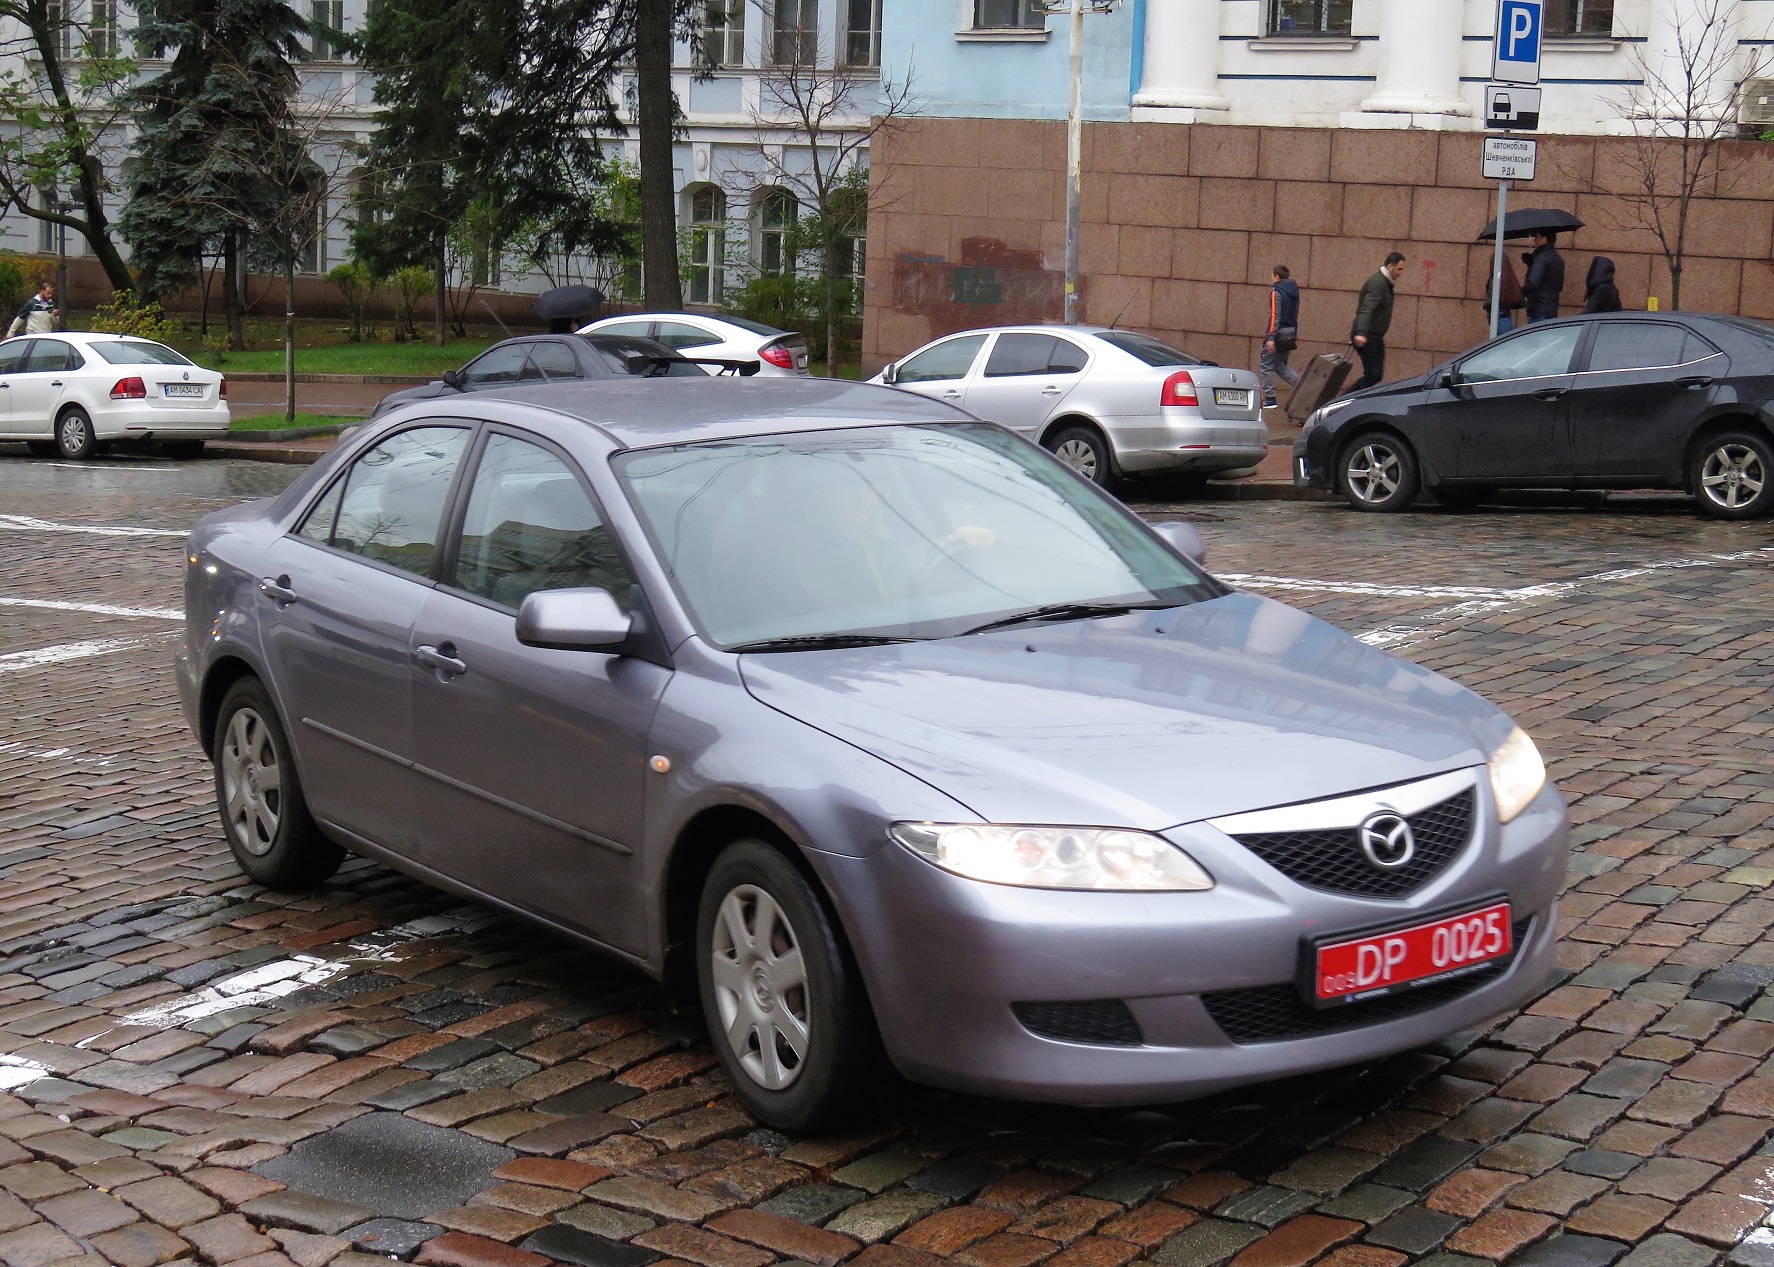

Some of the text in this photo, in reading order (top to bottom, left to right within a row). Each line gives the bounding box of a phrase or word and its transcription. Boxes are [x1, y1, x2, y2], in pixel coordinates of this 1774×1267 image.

[1508, 7, 1532, 57] P
[1493, 141, 1528, 151] автомобілів
[1486, 152, 1534, 164] Шевченківської
[1502, 166, 1516, 176] РДА
[1357, 938, 1407, 986] DP
[1432, 912, 1502, 968] 0025
